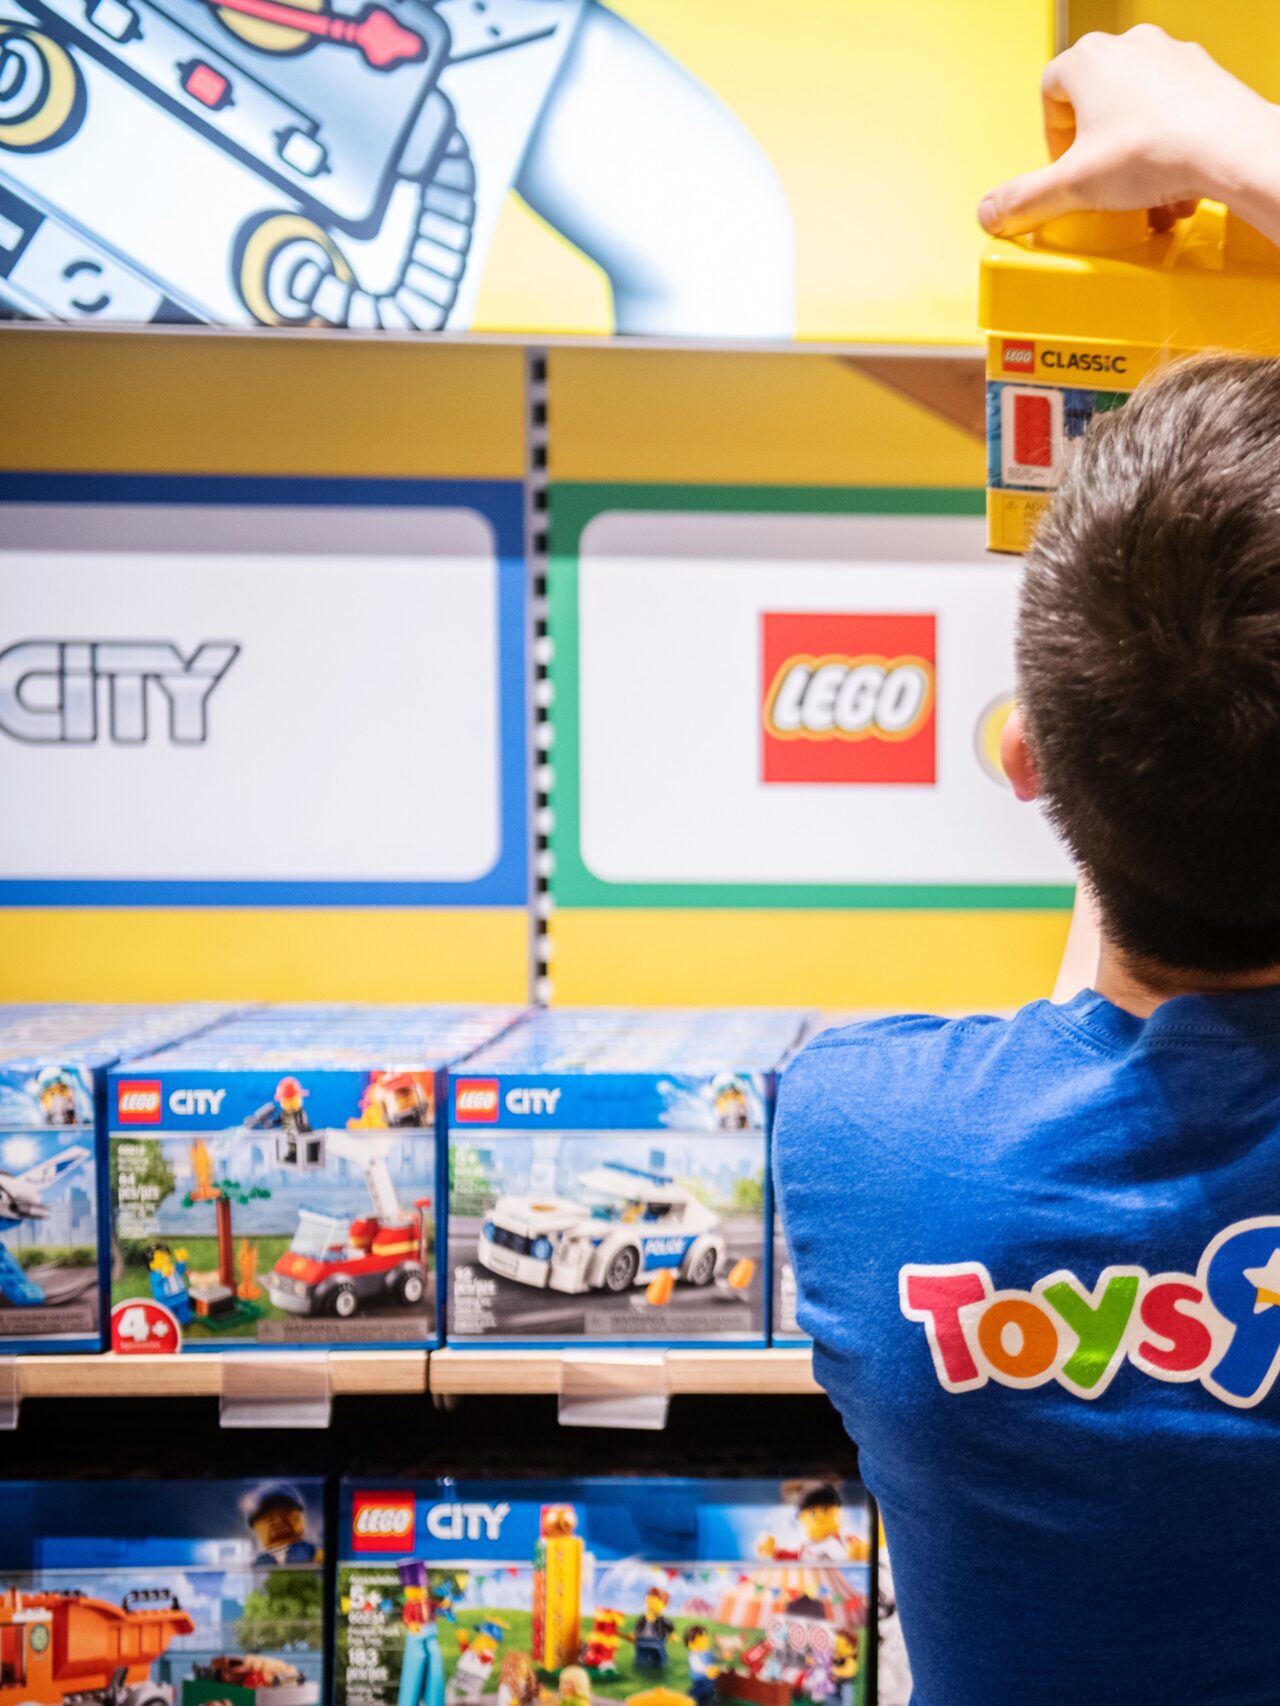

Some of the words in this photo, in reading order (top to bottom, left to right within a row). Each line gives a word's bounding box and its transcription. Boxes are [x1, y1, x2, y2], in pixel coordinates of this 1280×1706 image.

[1005, 349, 1033, 363] LEGO
[1041, 350, 1127, 374] CLASSIC
[0, 640, 240, 743] CITY
[768, 658, 932, 736] LEGO
[169, 1089, 226, 1115] CITY
[505, 1088, 562, 1114] CITY
[118, 1308, 168, 1342] 4+
[356, 1507, 412, 1535] LEGO
[426, 1503, 511, 1540] CITY
